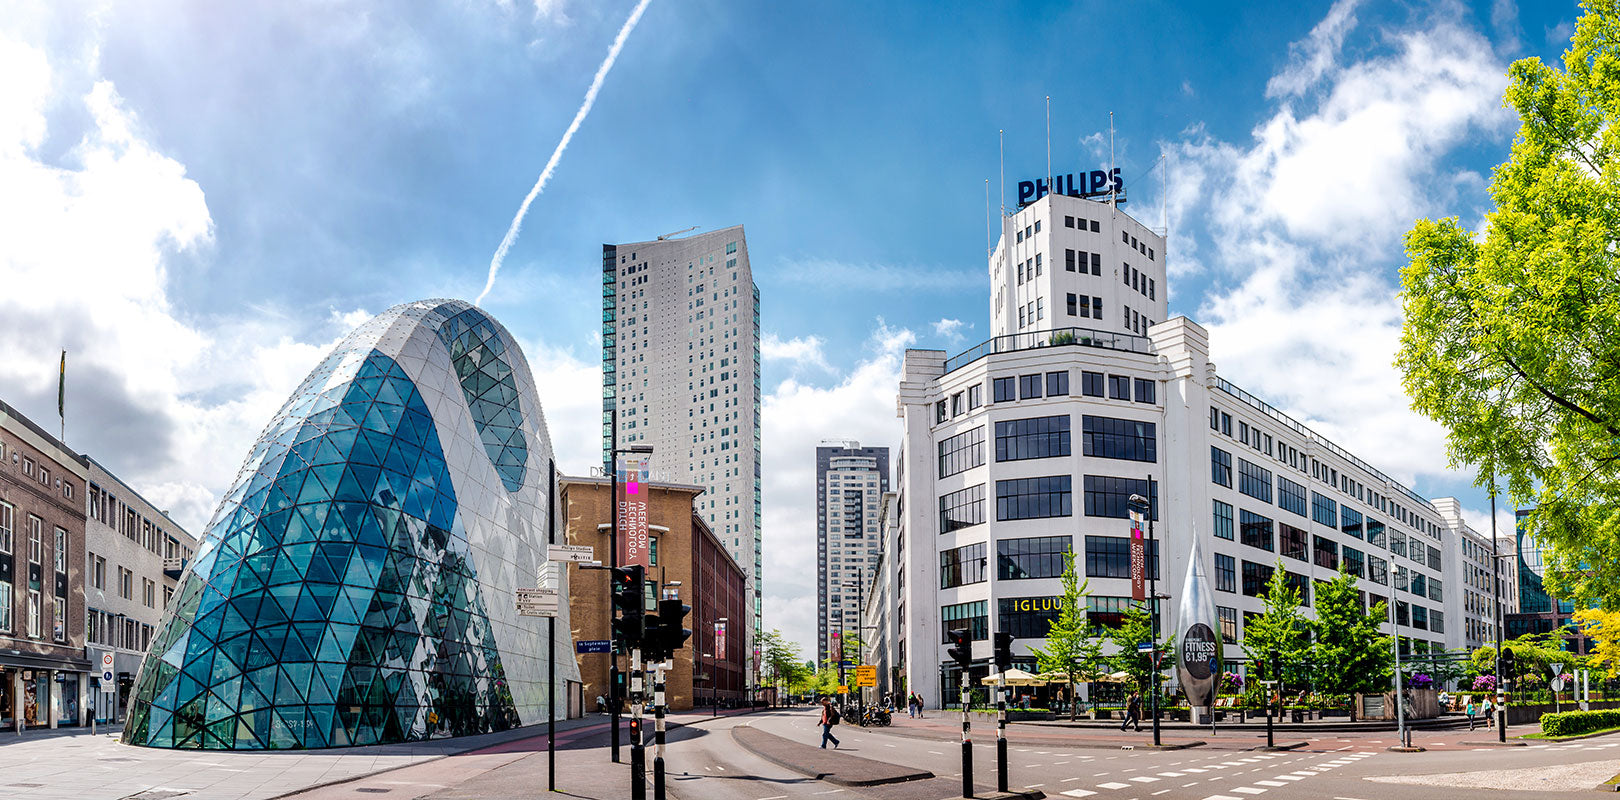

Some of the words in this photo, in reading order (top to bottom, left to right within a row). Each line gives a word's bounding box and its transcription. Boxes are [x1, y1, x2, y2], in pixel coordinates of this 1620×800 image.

[1018, 168, 1123, 205] PHILIPS
[1014, 599, 1062, 612] IGLUU
[1185, 642, 1216, 652] FITNESS
[1185, 652, 1208, 662] €1,95
